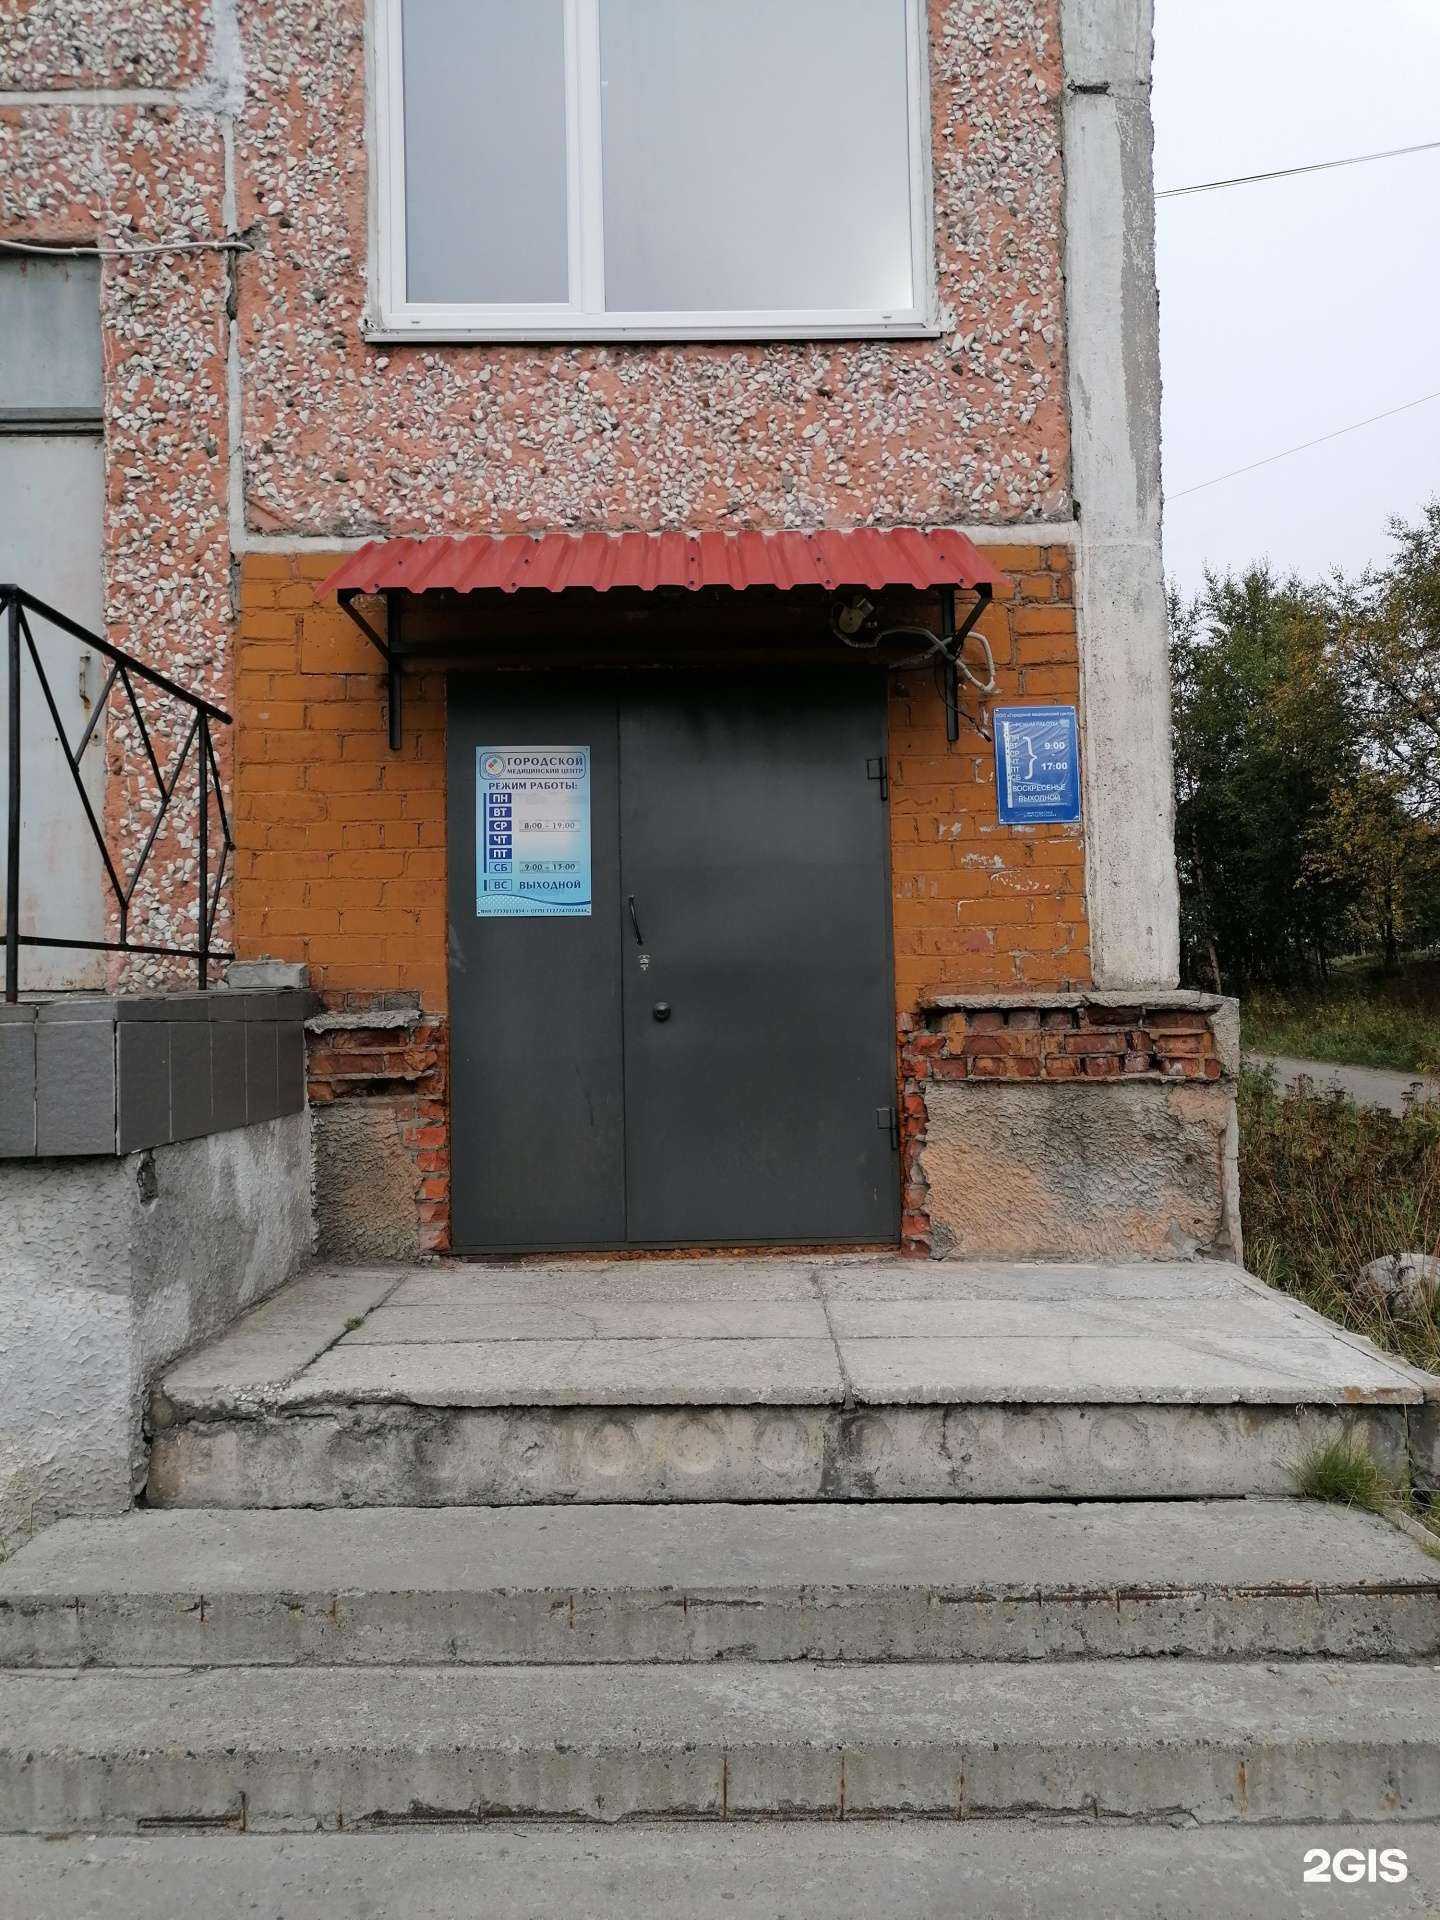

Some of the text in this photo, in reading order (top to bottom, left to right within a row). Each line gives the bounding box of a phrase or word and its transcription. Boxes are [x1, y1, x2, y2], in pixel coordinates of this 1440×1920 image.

[1044, 741, 1065, 750] 9:00
[507, 756, 583, 766] ГОРОДСКОЙ
[1041, 762, 1068, 770] 17:00
[489, 781, 577, 790] РЕЖИМ РАБОТЫ:
[1013, 783, 1066, 792] ВОСКРЕСЕНЬЕ
[493, 794, 508, 802] ПН
[1018, 793, 1061, 801] ВЫХОДНОЙ
[493, 808, 508, 816] ВТ
[493, 822, 508, 830] СР
[493, 836, 508, 844] ЧТ
[493, 850, 508, 858] ПТ
[494, 863, 508, 872] СБ
[494, 880, 581, 890] ВС ВЫХОДНОЙ
